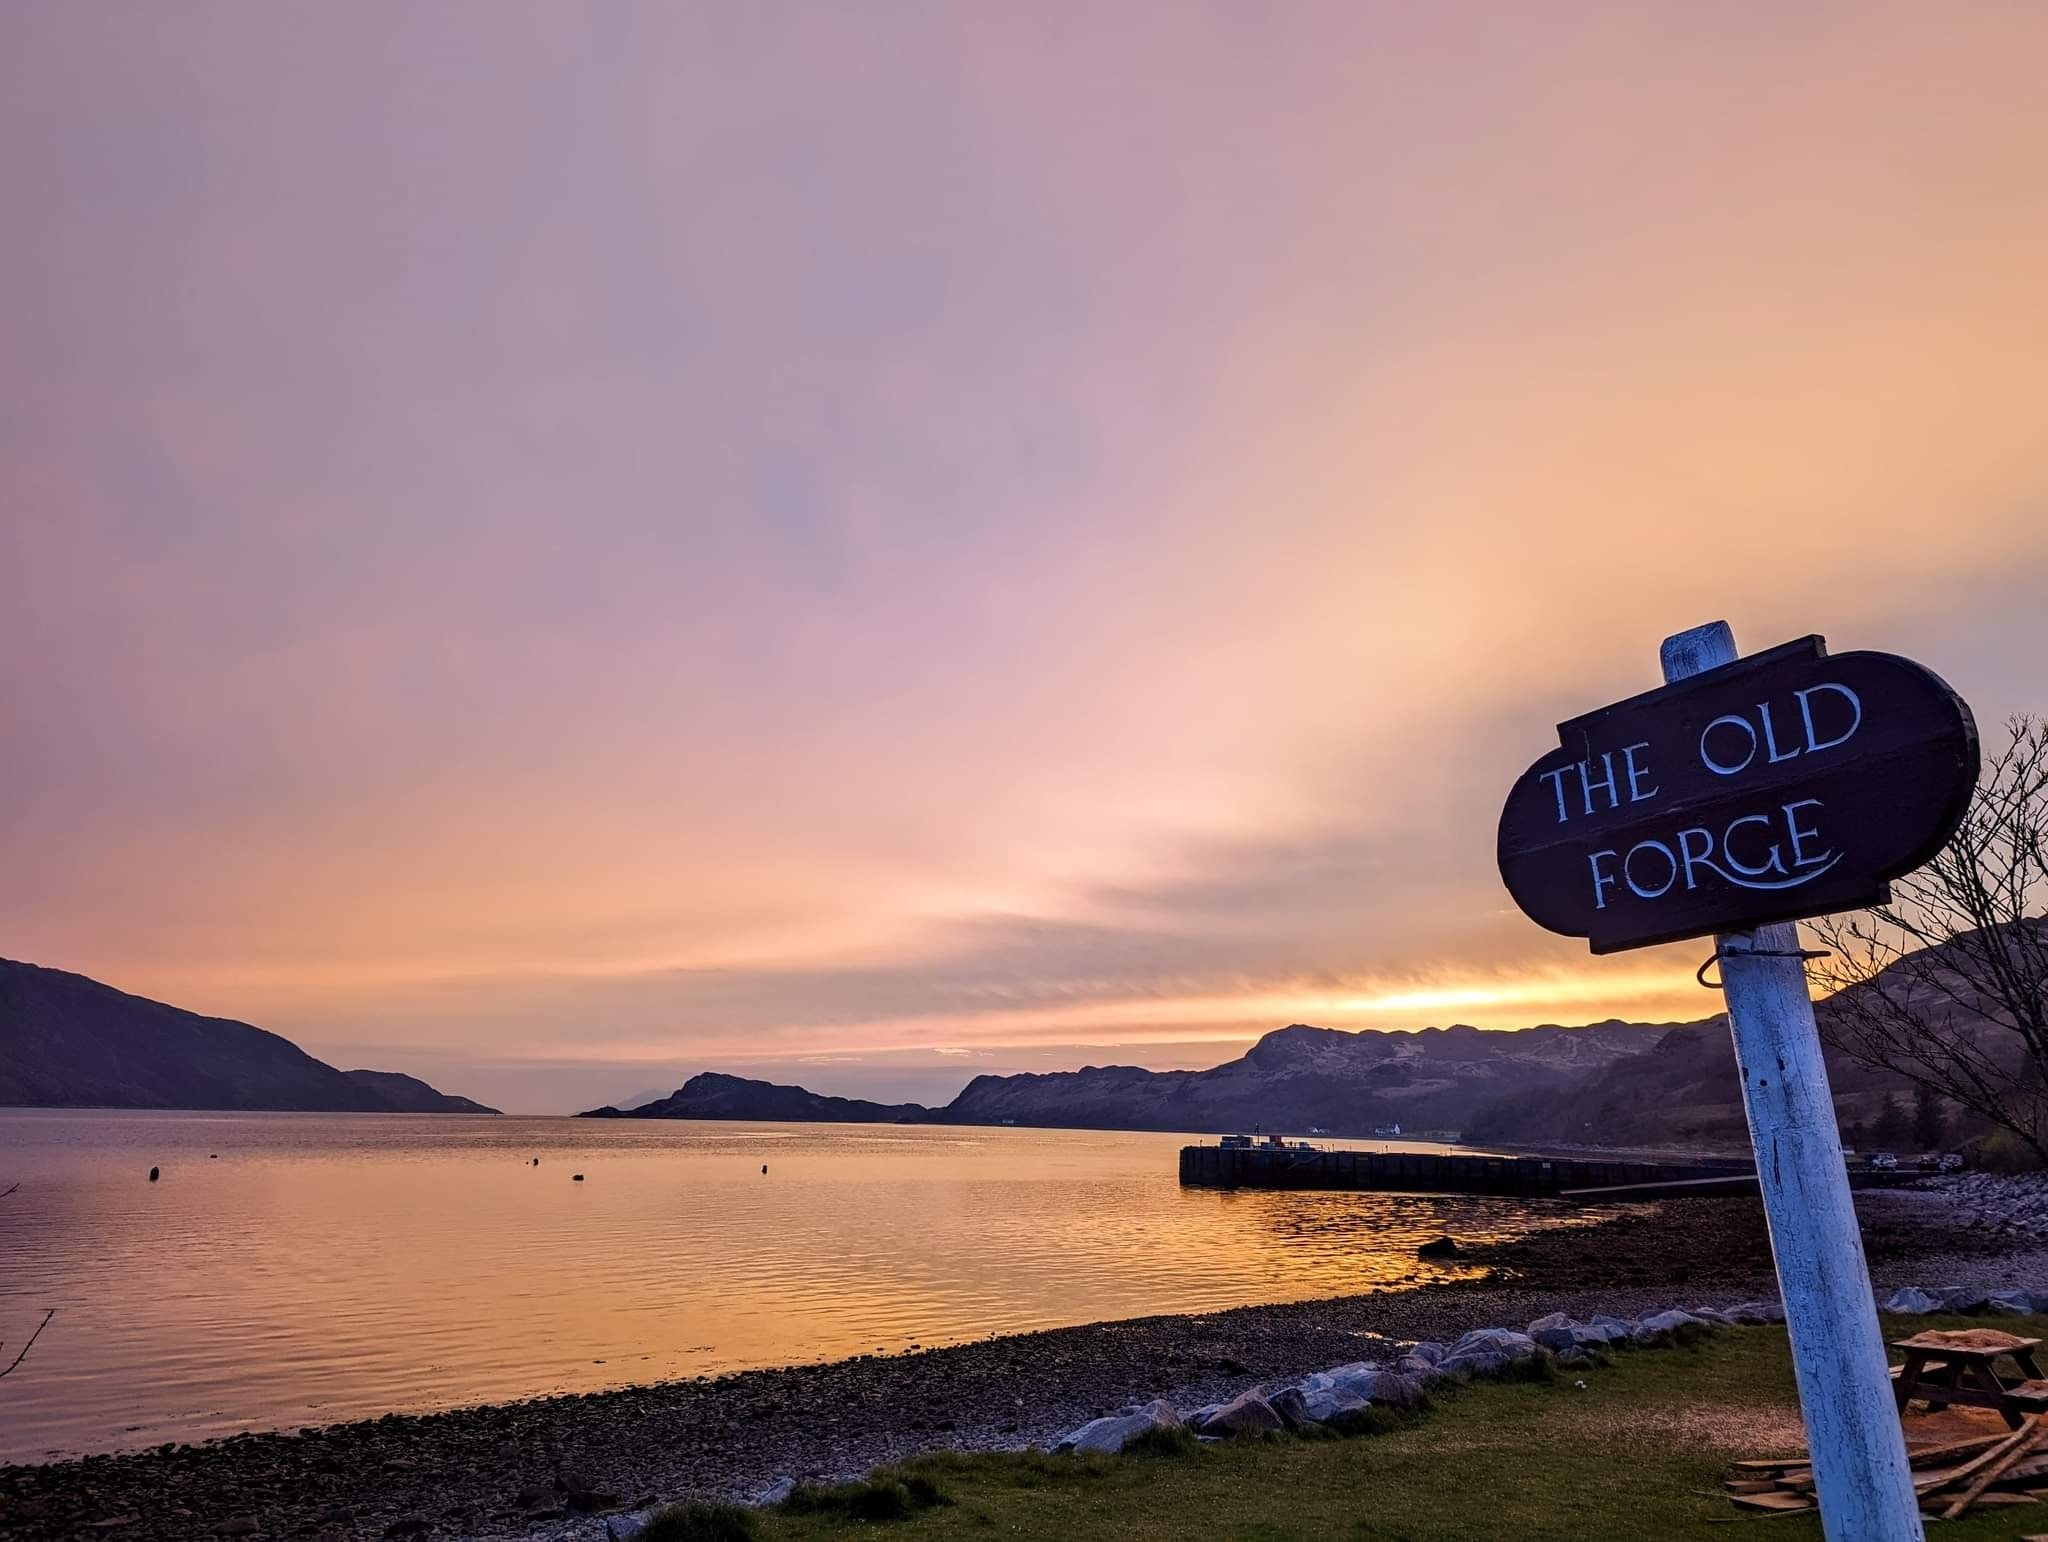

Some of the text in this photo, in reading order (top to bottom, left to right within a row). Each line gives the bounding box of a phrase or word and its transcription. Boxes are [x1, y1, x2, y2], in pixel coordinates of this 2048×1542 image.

[1540, 683, 1862, 823] THE OLD
[1588, 800, 1844, 909] FORGE
